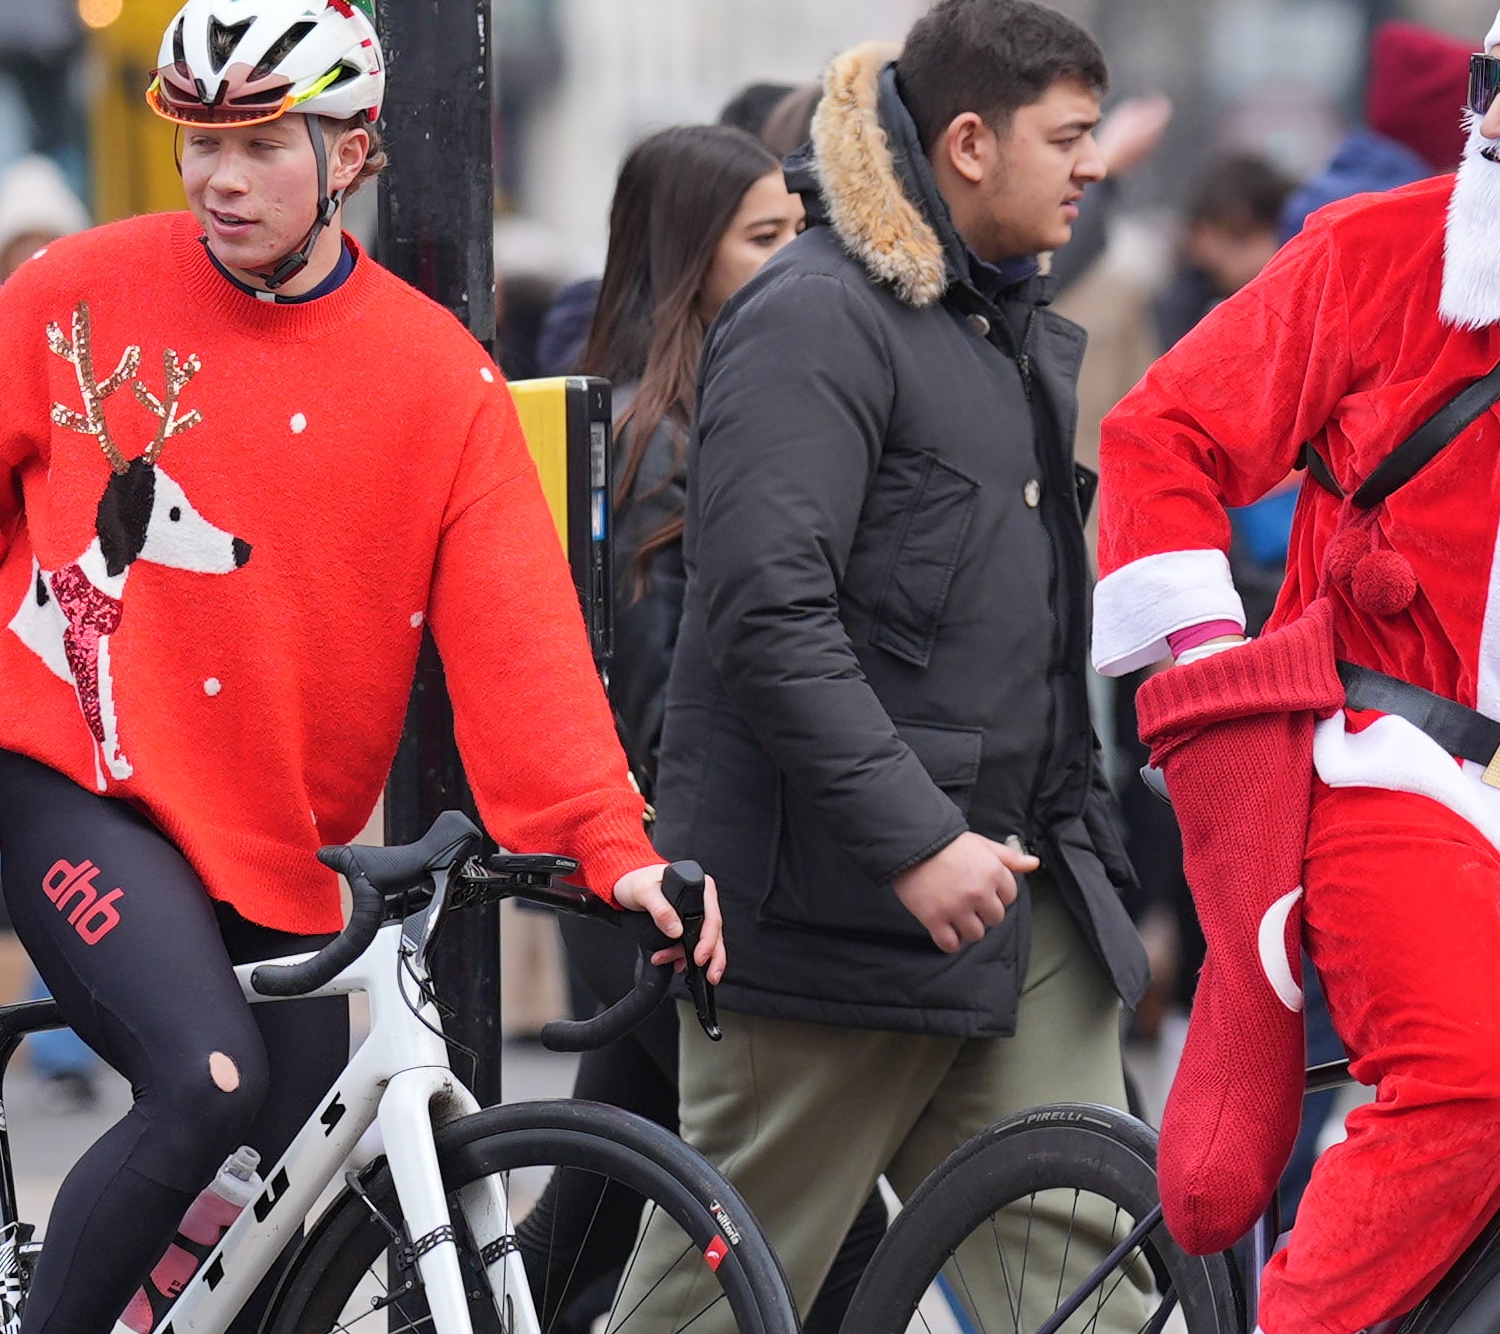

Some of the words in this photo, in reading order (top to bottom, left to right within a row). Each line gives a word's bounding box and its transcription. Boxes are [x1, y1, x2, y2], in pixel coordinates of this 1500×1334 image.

[41, 858, 126, 946] dhb
[1026, 1111, 1083, 1125] PIRELLI
[714, 1208, 742, 1246] vittoria
